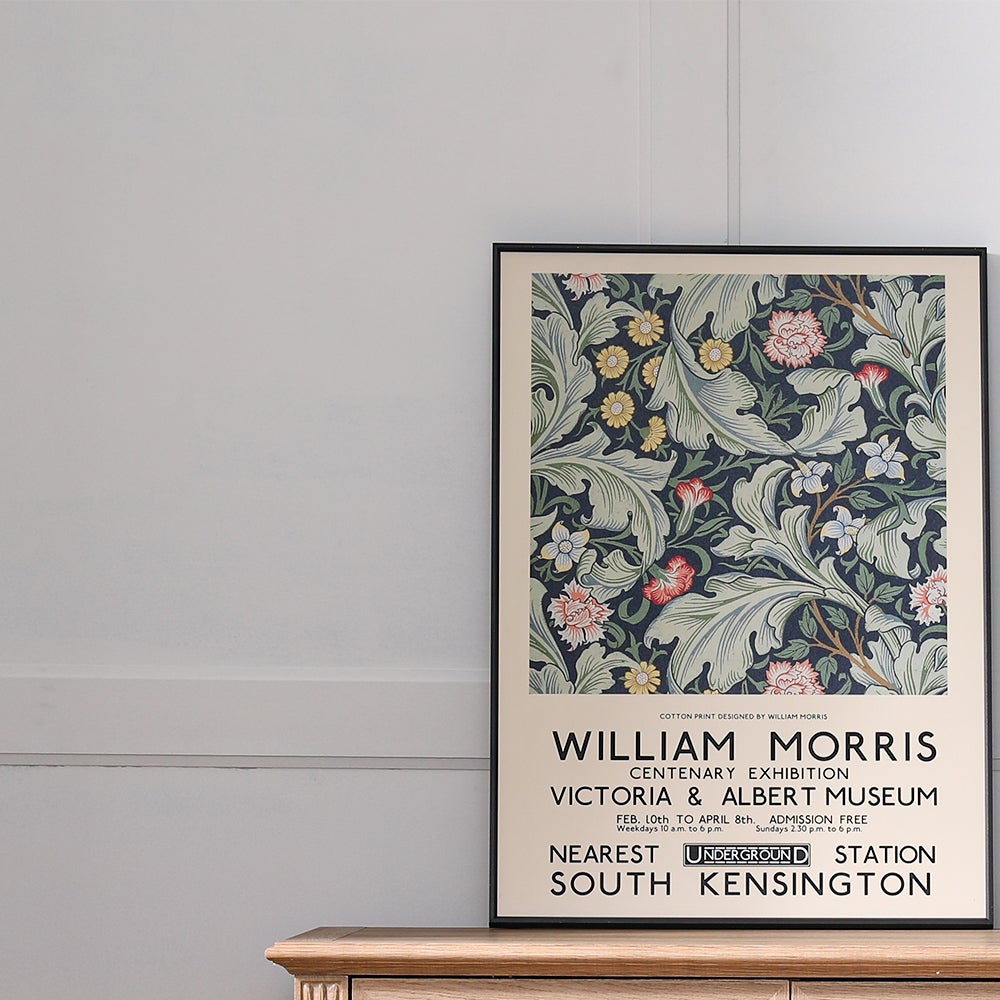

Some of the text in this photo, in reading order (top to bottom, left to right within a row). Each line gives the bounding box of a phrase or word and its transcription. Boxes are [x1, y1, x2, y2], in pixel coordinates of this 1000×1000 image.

[552, 731, 937, 762] WILLIAM MORRIS
[630, 767, 849, 780] CENTENARY EXHIBITION
[550, 786, 938, 806] VICTORIA & ALBERT MUSEUM
[616, 814, 641, 824] FEB.
[676, 814, 694, 824] TO
[699, 814, 730, 824] APRIL
[769, 814, 833, 824] ADMISSION
[840, 814, 868, 824] FREE
[616, 825, 658, 834] Weekdays
[755, 825, 789, 834] Sundays
[550, 844, 936, 864] NEAREST UNDERGROUND STATION
[551, 871, 931, 896] SOUTH KENSINGTON
